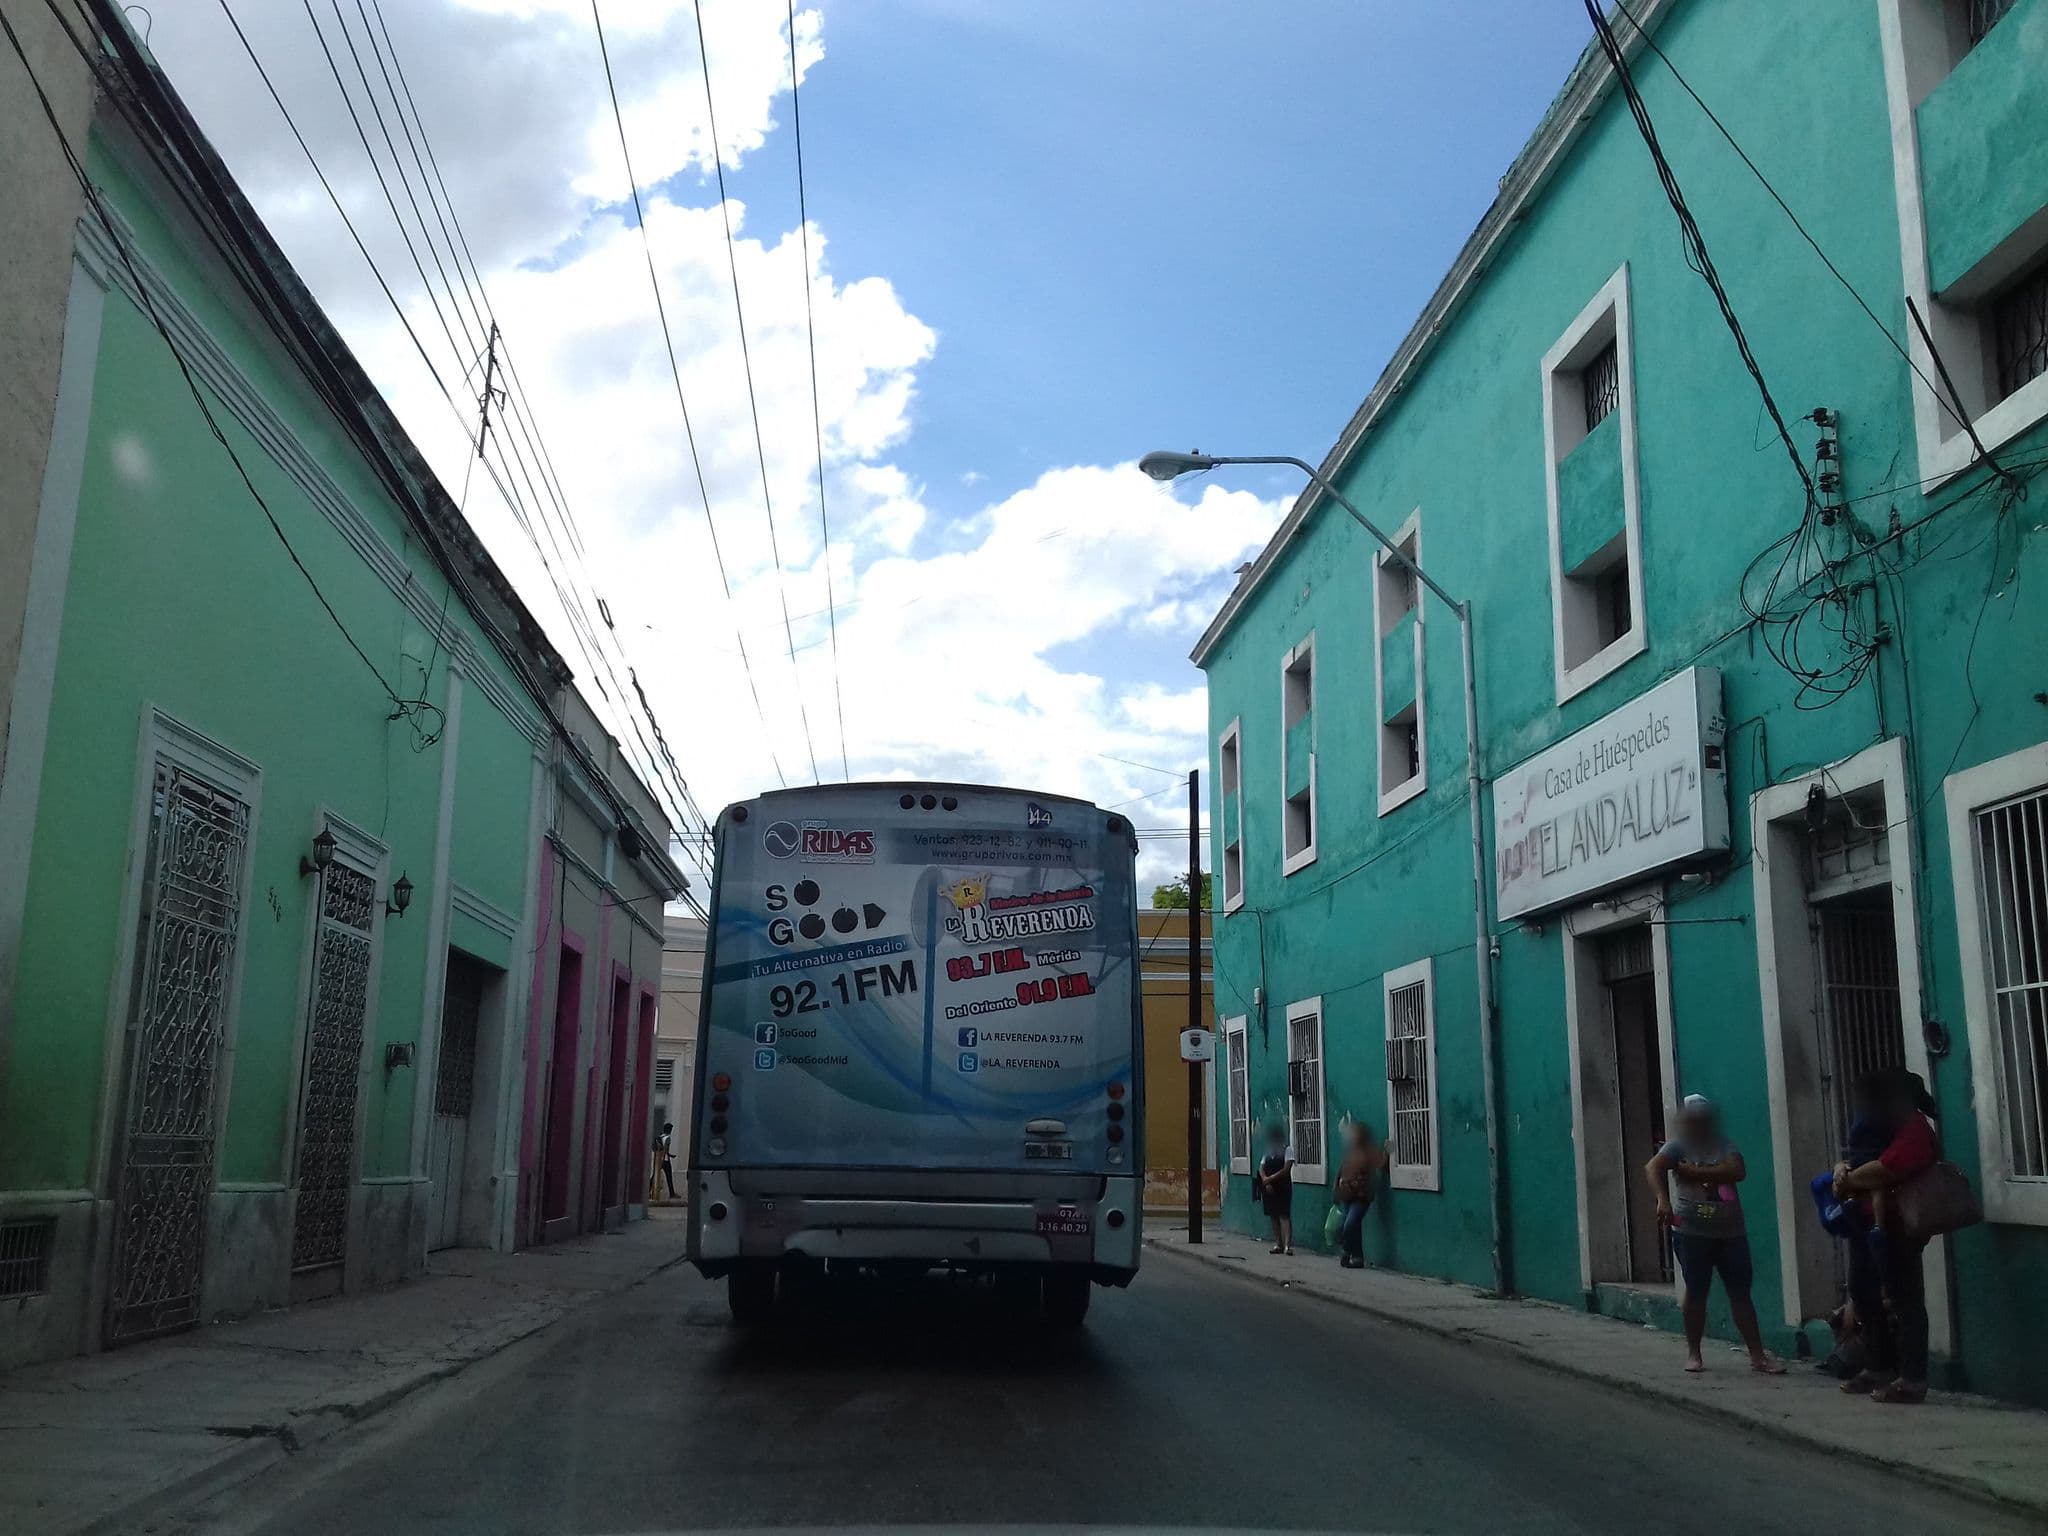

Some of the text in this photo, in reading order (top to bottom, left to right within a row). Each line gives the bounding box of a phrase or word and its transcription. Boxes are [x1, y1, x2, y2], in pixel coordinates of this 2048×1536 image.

[1544, 768, 1573, 799] Casa
[1575, 751, 1591, 785] de
[1592, 711, 1670, 776] Huéspedes
[961, 903, 1094, 943] REVERENDA
[774, 953, 844, 972] Alternativa
[847, 950, 864, 960] en
[1037, 950, 1081, 966] Mérida
[945, 1003, 968, 1020] Del
[969, 997, 1017, 1016] Oriente
[980, 1032, 993, 1041] LA
[994, 1032, 1048, 1043] REVERENDA
[1049, 1034, 1068, 1044] 93.7
[1070, 1035, 1084, 1044] FM
